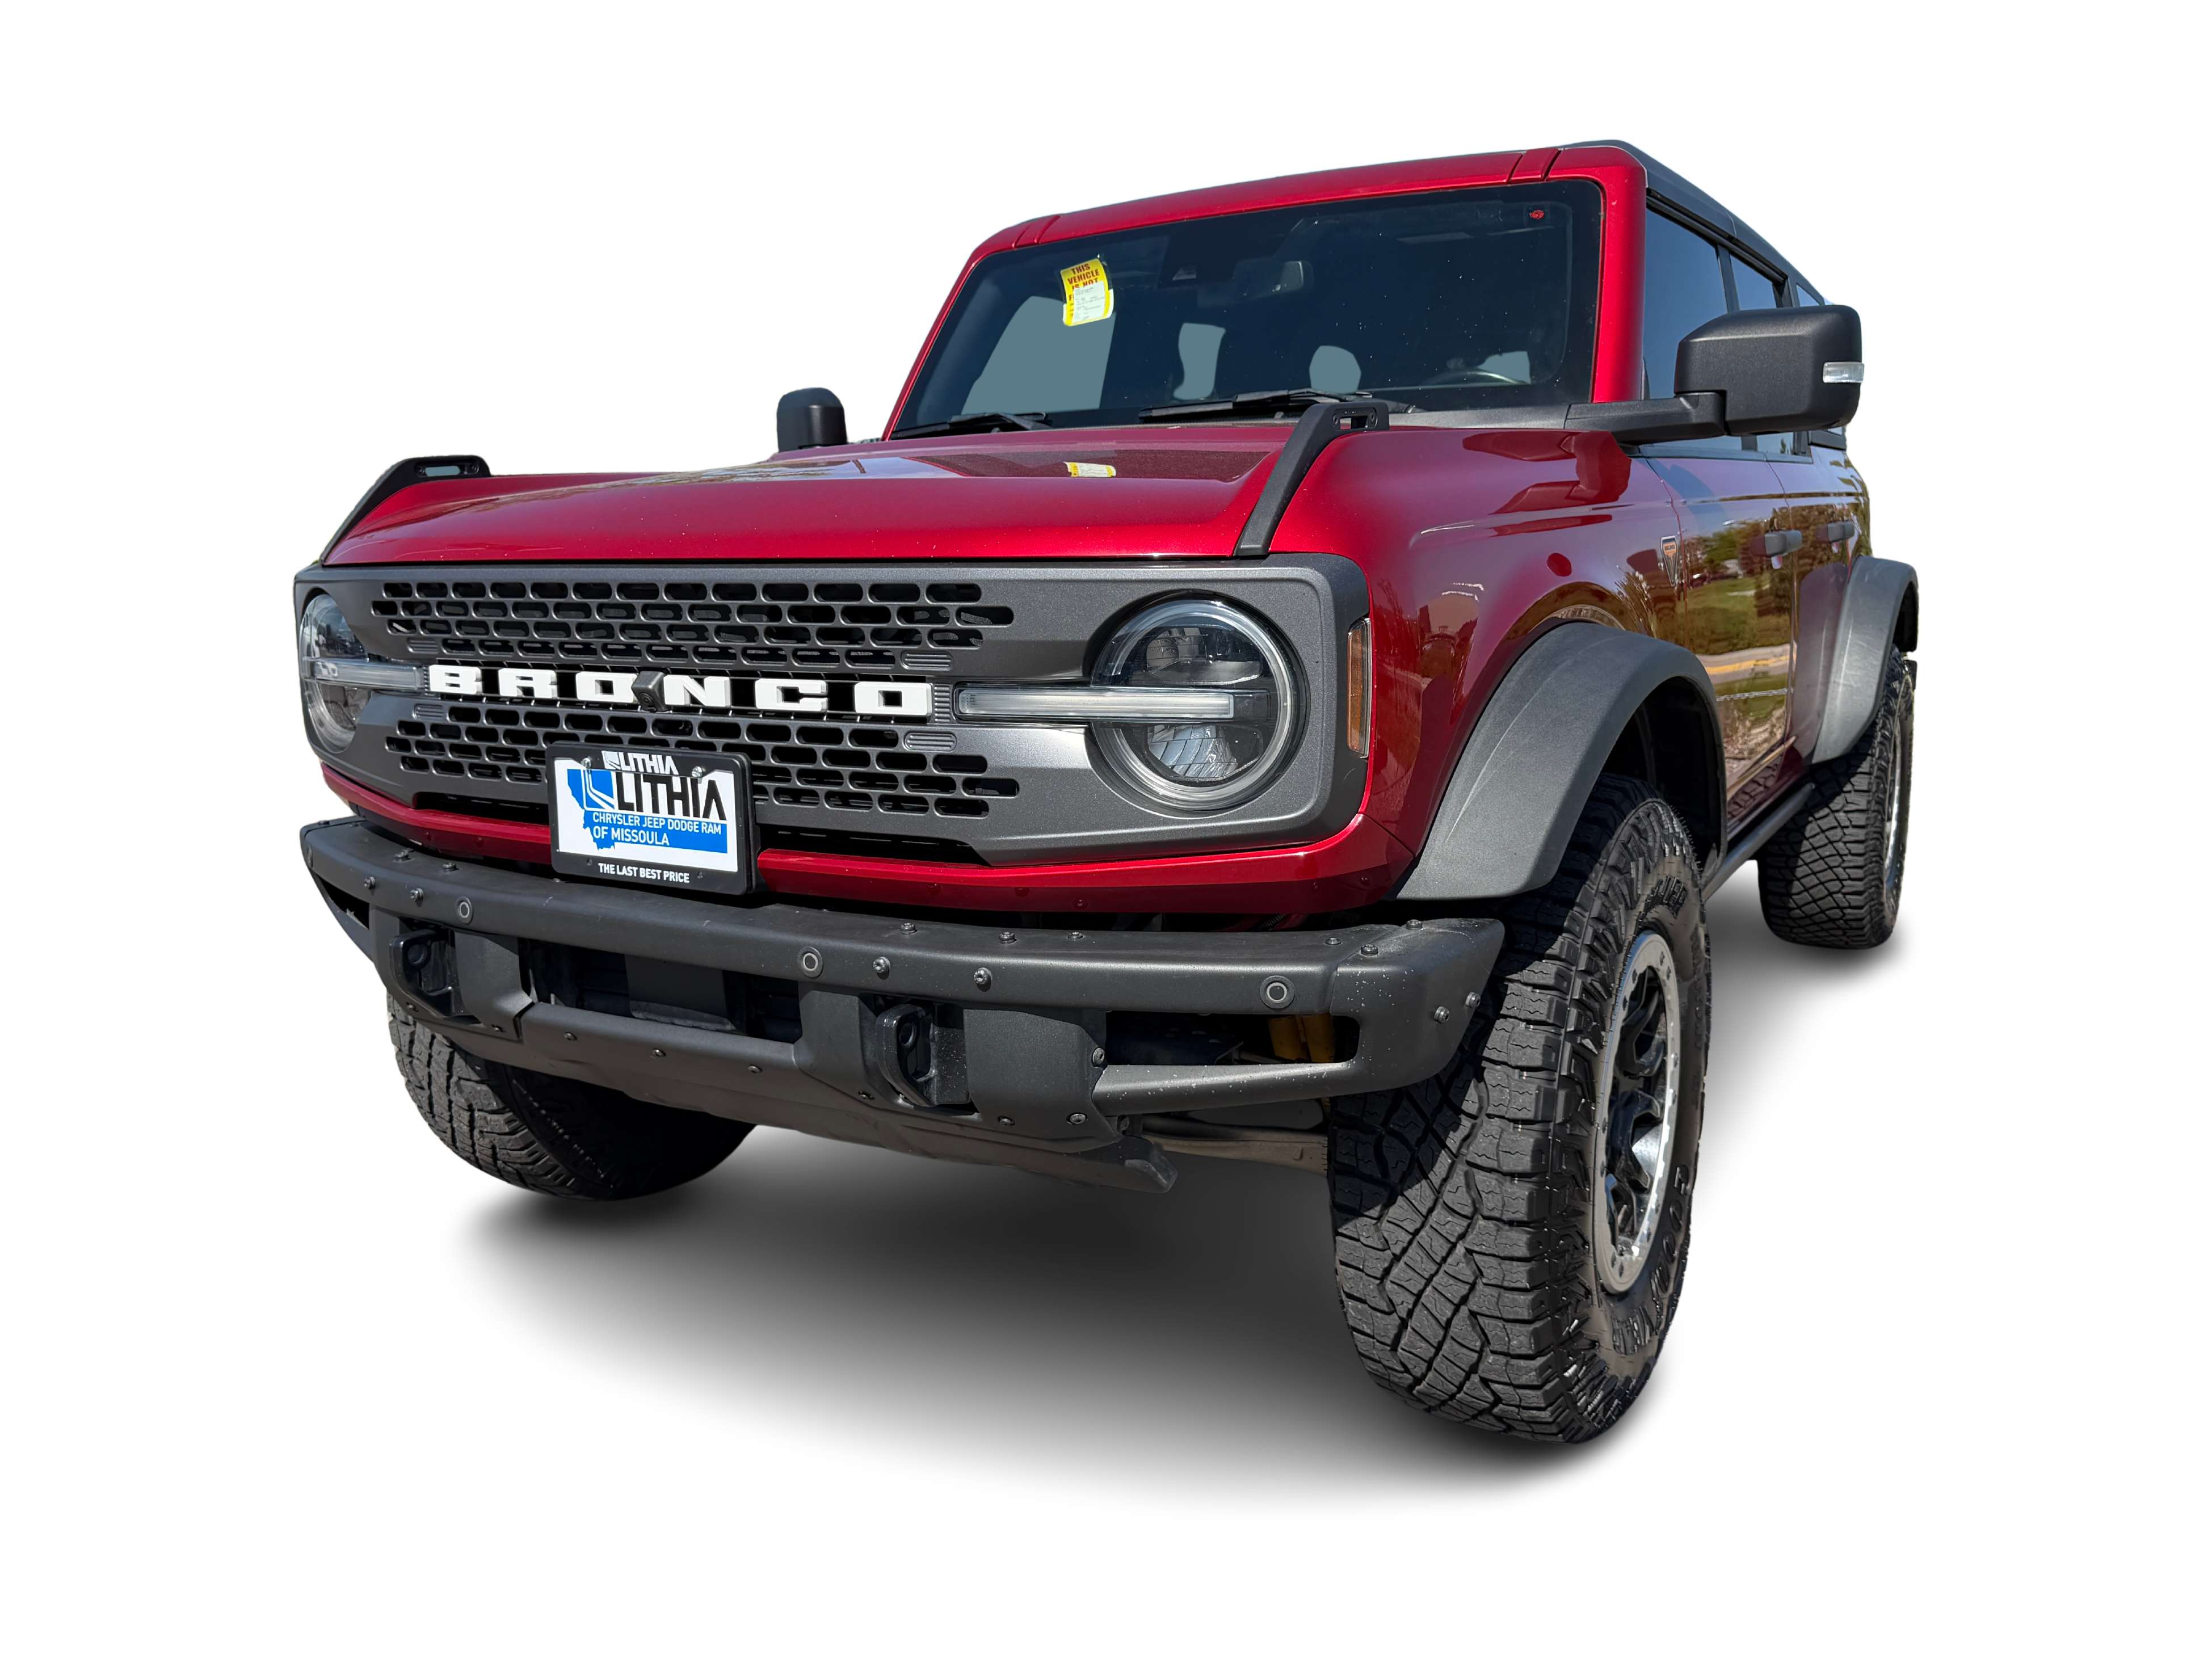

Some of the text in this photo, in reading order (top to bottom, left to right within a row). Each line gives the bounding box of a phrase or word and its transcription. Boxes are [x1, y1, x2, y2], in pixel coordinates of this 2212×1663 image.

[1067, 269, 1100, 285] VEHICLE
[1070, 263, 1090, 275] THIS
[430, 665, 932, 717] BRONCO
[619, 752, 679, 775] LITHIA
[615, 771, 727, 821] LITHIA
[592, 812, 721, 835] CHRYSLER JEEP DODGE RAM
[593, 826, 670, 846] OF MISSOULA
[598, 863, 690, 883] THE LAST BEST PRICE
